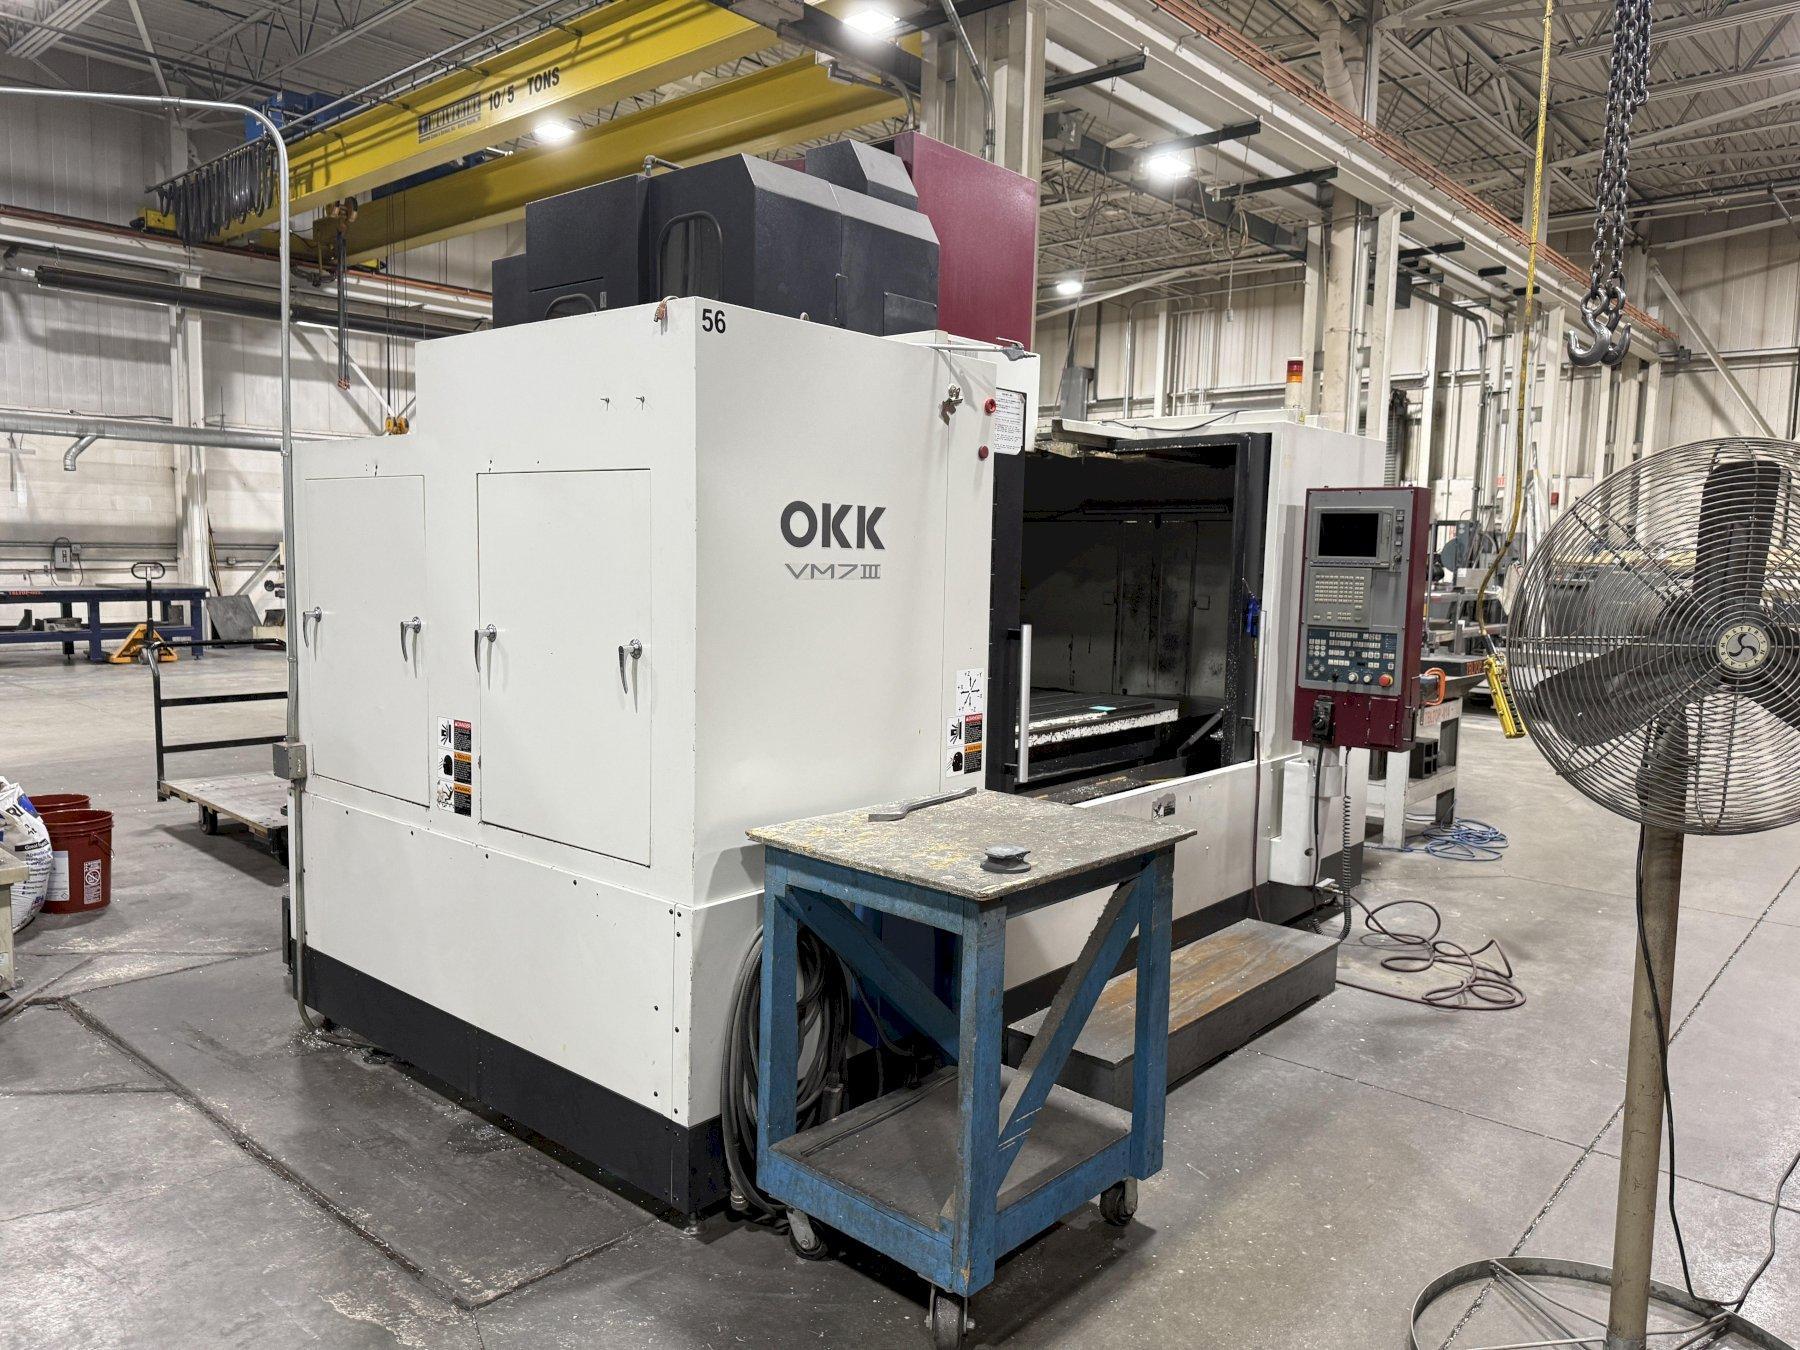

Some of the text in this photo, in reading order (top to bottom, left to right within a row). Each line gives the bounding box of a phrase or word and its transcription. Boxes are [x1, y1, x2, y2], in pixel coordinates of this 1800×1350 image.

[488, 66, 560, 111] 10/5 TONS
[702, 308, 726, 334] 56
[780, 500, 887, 550] OKK
